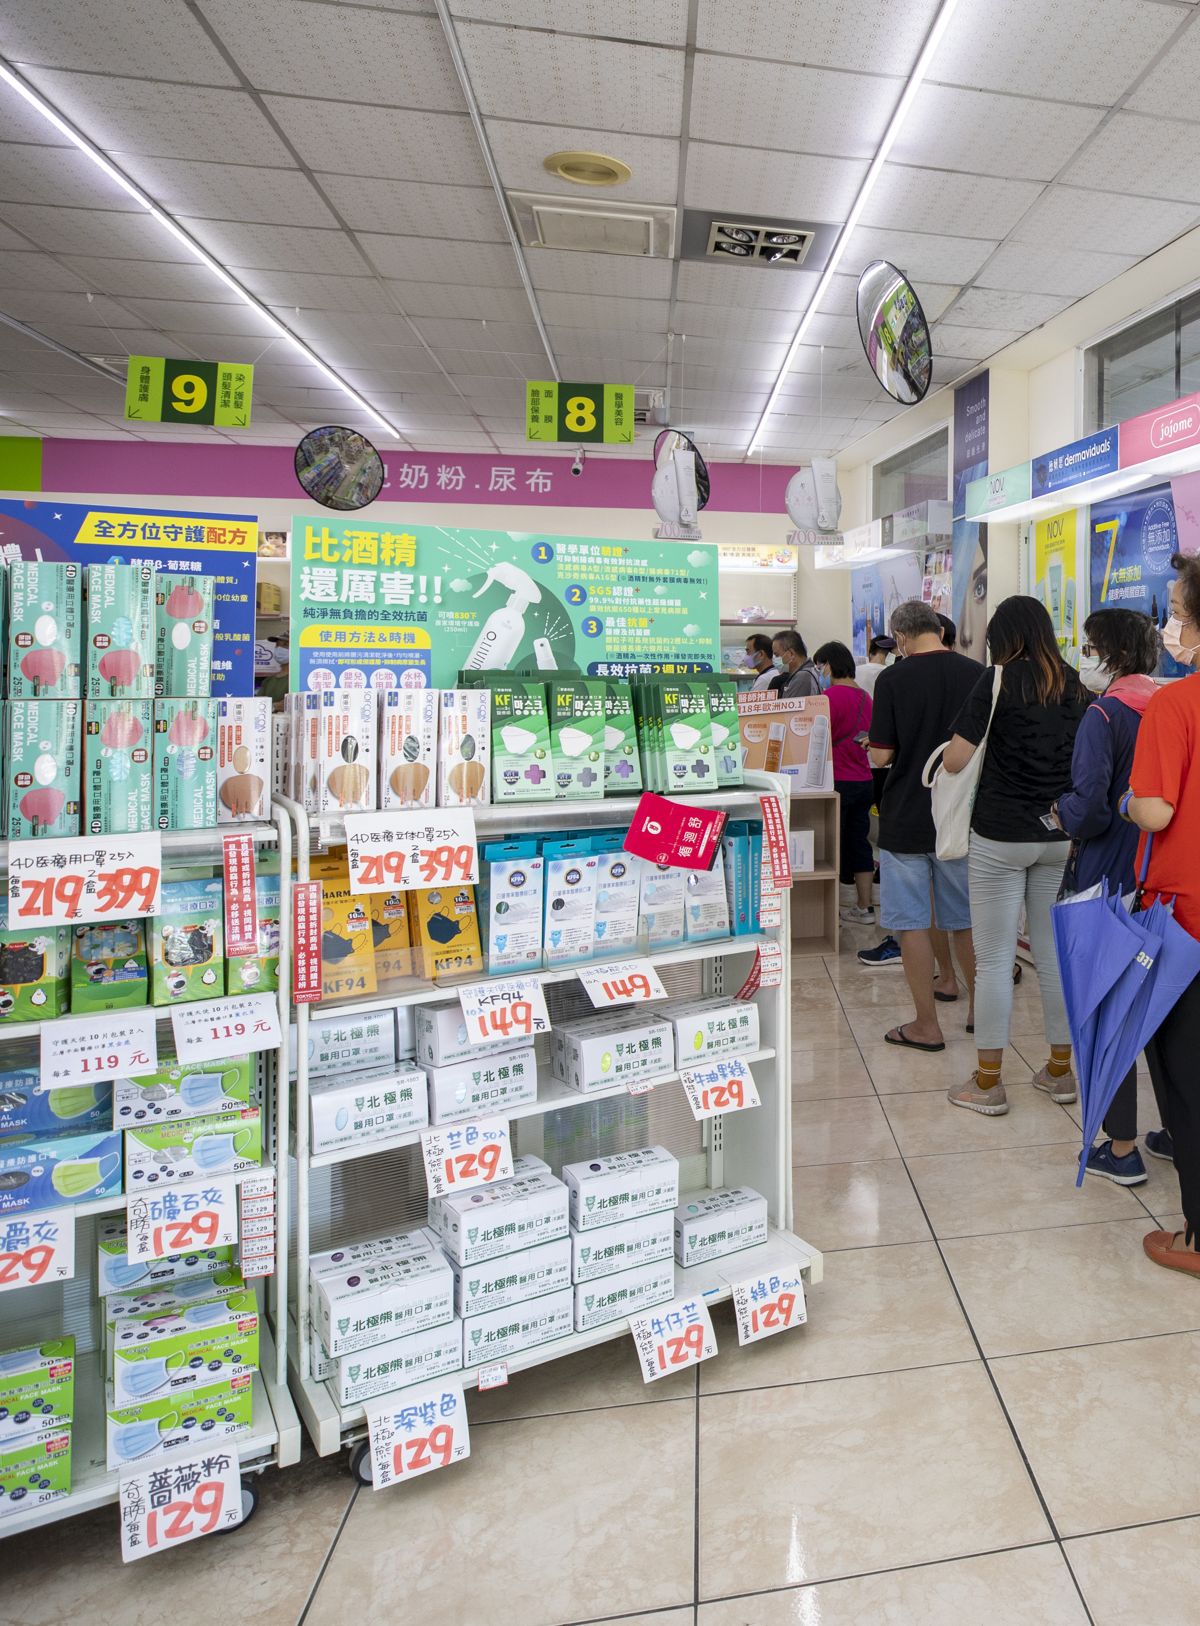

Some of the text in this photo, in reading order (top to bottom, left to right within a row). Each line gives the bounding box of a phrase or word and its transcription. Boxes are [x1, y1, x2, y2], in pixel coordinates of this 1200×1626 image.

[171, 374, 208, 413] 9
[531, 389, 540, 423] 臉部保養
[565, 396, 597, 433] 8
[614, 392, 624, 426] 醫學美容
[966, 398, 986, 416] Smooth
[976, 413, 986, 425] and
[1159, 416, 1194, 439] jojome
[965, 426, 986, 443] delicate
[1064, 438, 1111, 467] dermaviduals
[990, 477, 1005, 496] NOV
[94, 519, 248, 545] 全方位守護配方
[1046, 517, 1065, 540] NOV
[303, 525, 417, 567] 比酒精
[538, 547, 547, 559] 1
[1095, 519, 1120, 602] 7
[12, 562, 24, 622] FACE MASK
[27, 562, 39, 606] MEDICAL
[91, 565, 102, 624] FACE MASK
[104, 564, 115, 608] MEDICAL
[299, 566, 443, 605] 還厲害!!
[571, 588, 581, 602] 2
[303, 607, 428, 622] 純淨無負擔的全效抗菌
[319, 630, 416, 644] 使用方法&時機
[587, 620, 597, 634] 3
[186, 656, 198, 696] MEDICAL
[199, 643, 209, 696] FACE MASK
[495, 694, 511, 706] KF
[514, 700, 542, 710] 마스크
[557, 694, 573, 706] KF
[574, 700, 603, 711] 마스크
[665, 693, 678, 704] KF
[681, 698, 707, 708] 마스크
[737, 700, 803, 714] 18年歐洲NO.1
[13, 702, 24, 762] FACE MASK
[27, 701, 38, 745] MEDICAL
[128, 788, 138, 832] MEDICAL
[141, 773, 150, 832] FACE MASK
[193, 785, 203, 828] MEDICAL
[206, 770, 216, 827] FACE MASK
[357, 851, 406, 886] 219
[419, 845, 474, 883] 399
[18, 875, 86, 919] 219
[94, 866, 160, 913] 399
[375, 960, 402, 974] F94
[435, 954, 473, 971] KF94
[324, 976, 366, 994] KF94
[602, 974, 651, 1000] 149
[478, 991, 523, 1006] KF94
[252, 1019, 272, 1034] 元
[478, 1001, 532, 1037] 149
[716, 1015, 749, 1032] 北極熊
[210, 1023, 246, 1040] 119
[333, 1024, 380, 1043] 北極熊
[625, 1037, 662, 1054] 北極熊
[81, 1055, 120, 1073] 119
[128, 1050, 150, 1066] 元
[483, 1063, 524, 1084] 北極熊
[221, 1102, 234, 1111] 50
[367, 1087, 413, 1109] 北極熊
[702, 1080, 744, 1110] 129
[1, 1118, 28, 1128] MASK
[233, 1162, 246, 1171] 50
[445, 1144, 501, 1184] 129
[95, 1187, 106, 1195] 50
[2, 1198, 30, 1209] MASK
[149, 1186, 225, 1222] 礦石灰
[152, 1211, 220, 1257] 129
[480, 1222, 517, 1242] 北極熊
[208, 1262, 218, 1271] 50
[481, 1273, 518, 1295] 北極熊
[352, 1310, 393, 1333] 北極熊
[751, 1293, 796, 1334] 129
[657, 1324, 704, 1370] 129
[362, 1357, 404, 1380] 北極熊
[394, 1393, 457, 1432] 深紫色
[393, 1424, 454, 1476] 129
[149, 1454, 231, 1509] 薔薇粉
[147, 1481, 225, 1549] 129
